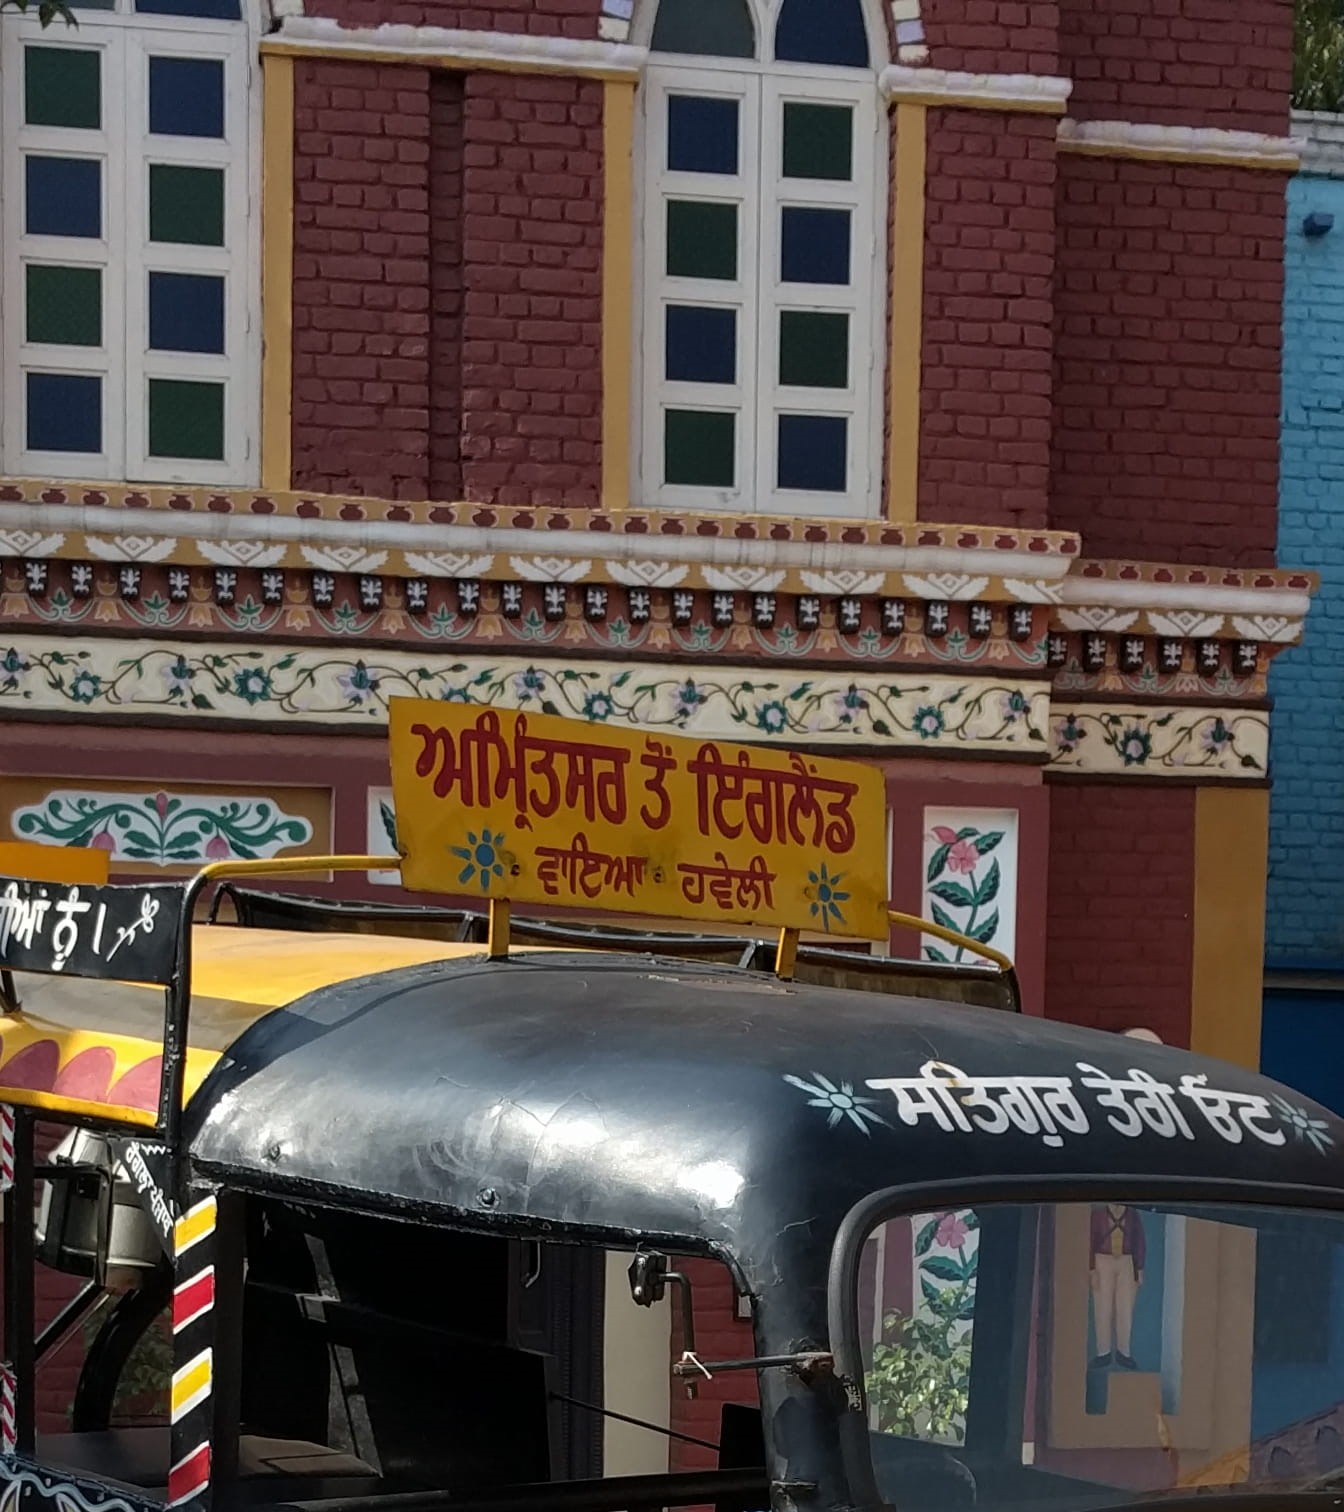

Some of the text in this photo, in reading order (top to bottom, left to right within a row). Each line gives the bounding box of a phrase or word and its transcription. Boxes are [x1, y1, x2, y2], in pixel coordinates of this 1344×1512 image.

[640, 736, 677, 830] ਤੋਂ
[677, 852, 778, 910] ਹਵੇਲੀ
[1076, 1062, 1195, 1141] ਤੇਰੀ
